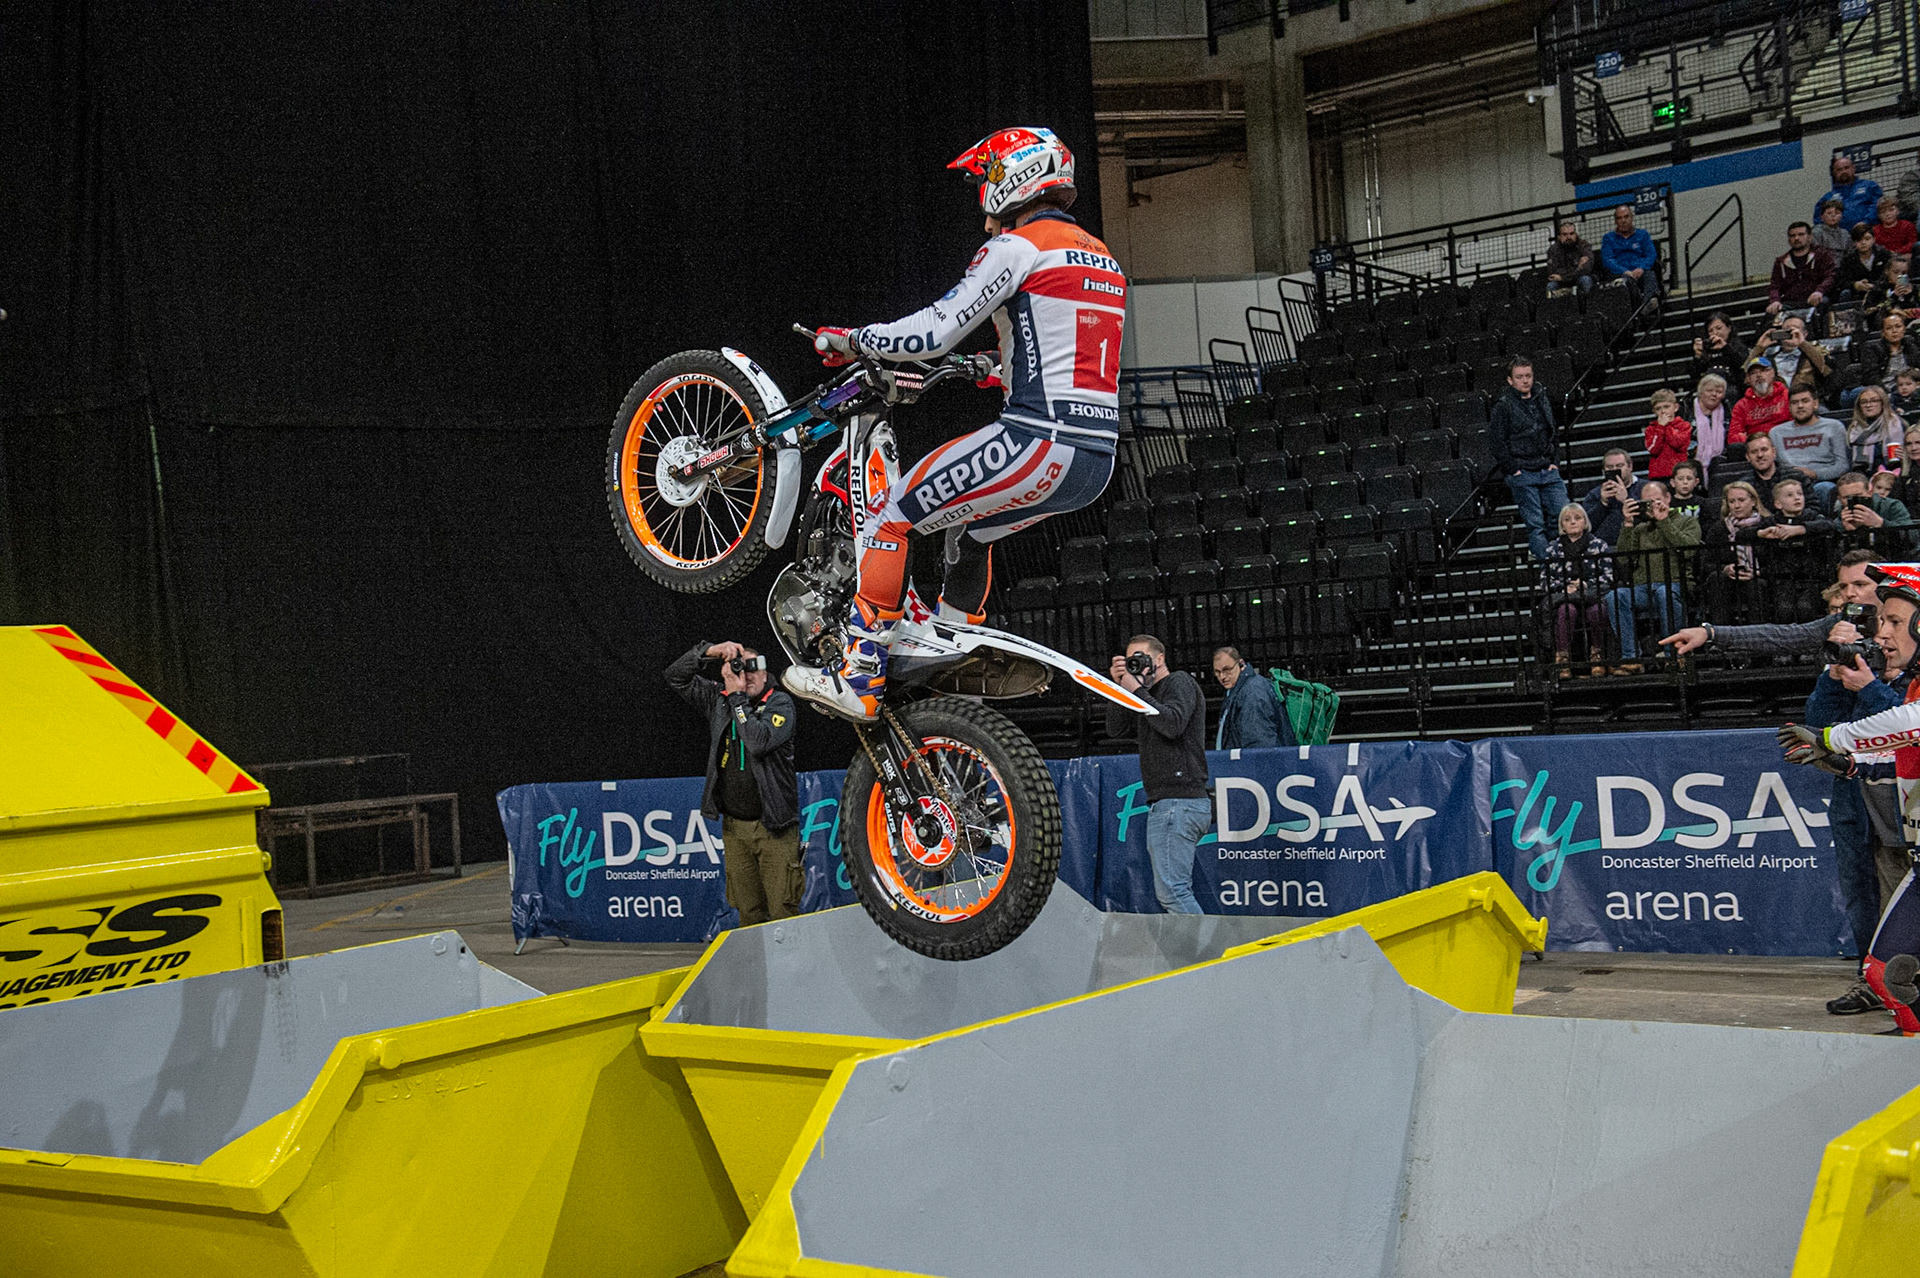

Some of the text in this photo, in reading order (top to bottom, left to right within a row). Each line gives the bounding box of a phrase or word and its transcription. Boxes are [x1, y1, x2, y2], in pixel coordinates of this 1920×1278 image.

[1598, 57, 1617, 69] 220
[990, 161, 1043, 211] hebo
[1636, 191, 1657, 203] 120
[1066, 250, 1123, 274] REPSO
[1315, 253, 1332, 264] 120
[956, 267, 1012, 327] hebo
[1083, 277, 1124, 297] hebo
[1018, 310, 1039, 382] HONDA
[1100, 338, 1108, 378] 1
[1068, 403, 1119, 421] HONDA
[700, 445, 729, 468] SHOWA
[914, 430, 1023, 514] REPSOL
[851, 465, 865, 535] REPSOL
[960, 460, 1064, 524] Montesa
[922, 503, 973, 533] hebo
[1854, 728, 1920, 749] HOND
[1215, 774, 1385, 843] DSA
[1491, 770, 1817, 892] Fly DSA
[537, 808, 720, 898] Fly DSA
[1217, 847, 1386, 862] Doncaster Sheffield Airport
[1602, 854, 1817, 872] Doncaster Sheffield Airport
[605, 868, 719, 882] Doncaster Sheffield Airport
[607, 894, 684, 918] arena
[895, 892, 942, 921] REPSOL
[1219, 879, 1328, 907] arena
[1605, 891, 1743, 922] arena
[141, 950, 191, 973] LTD
